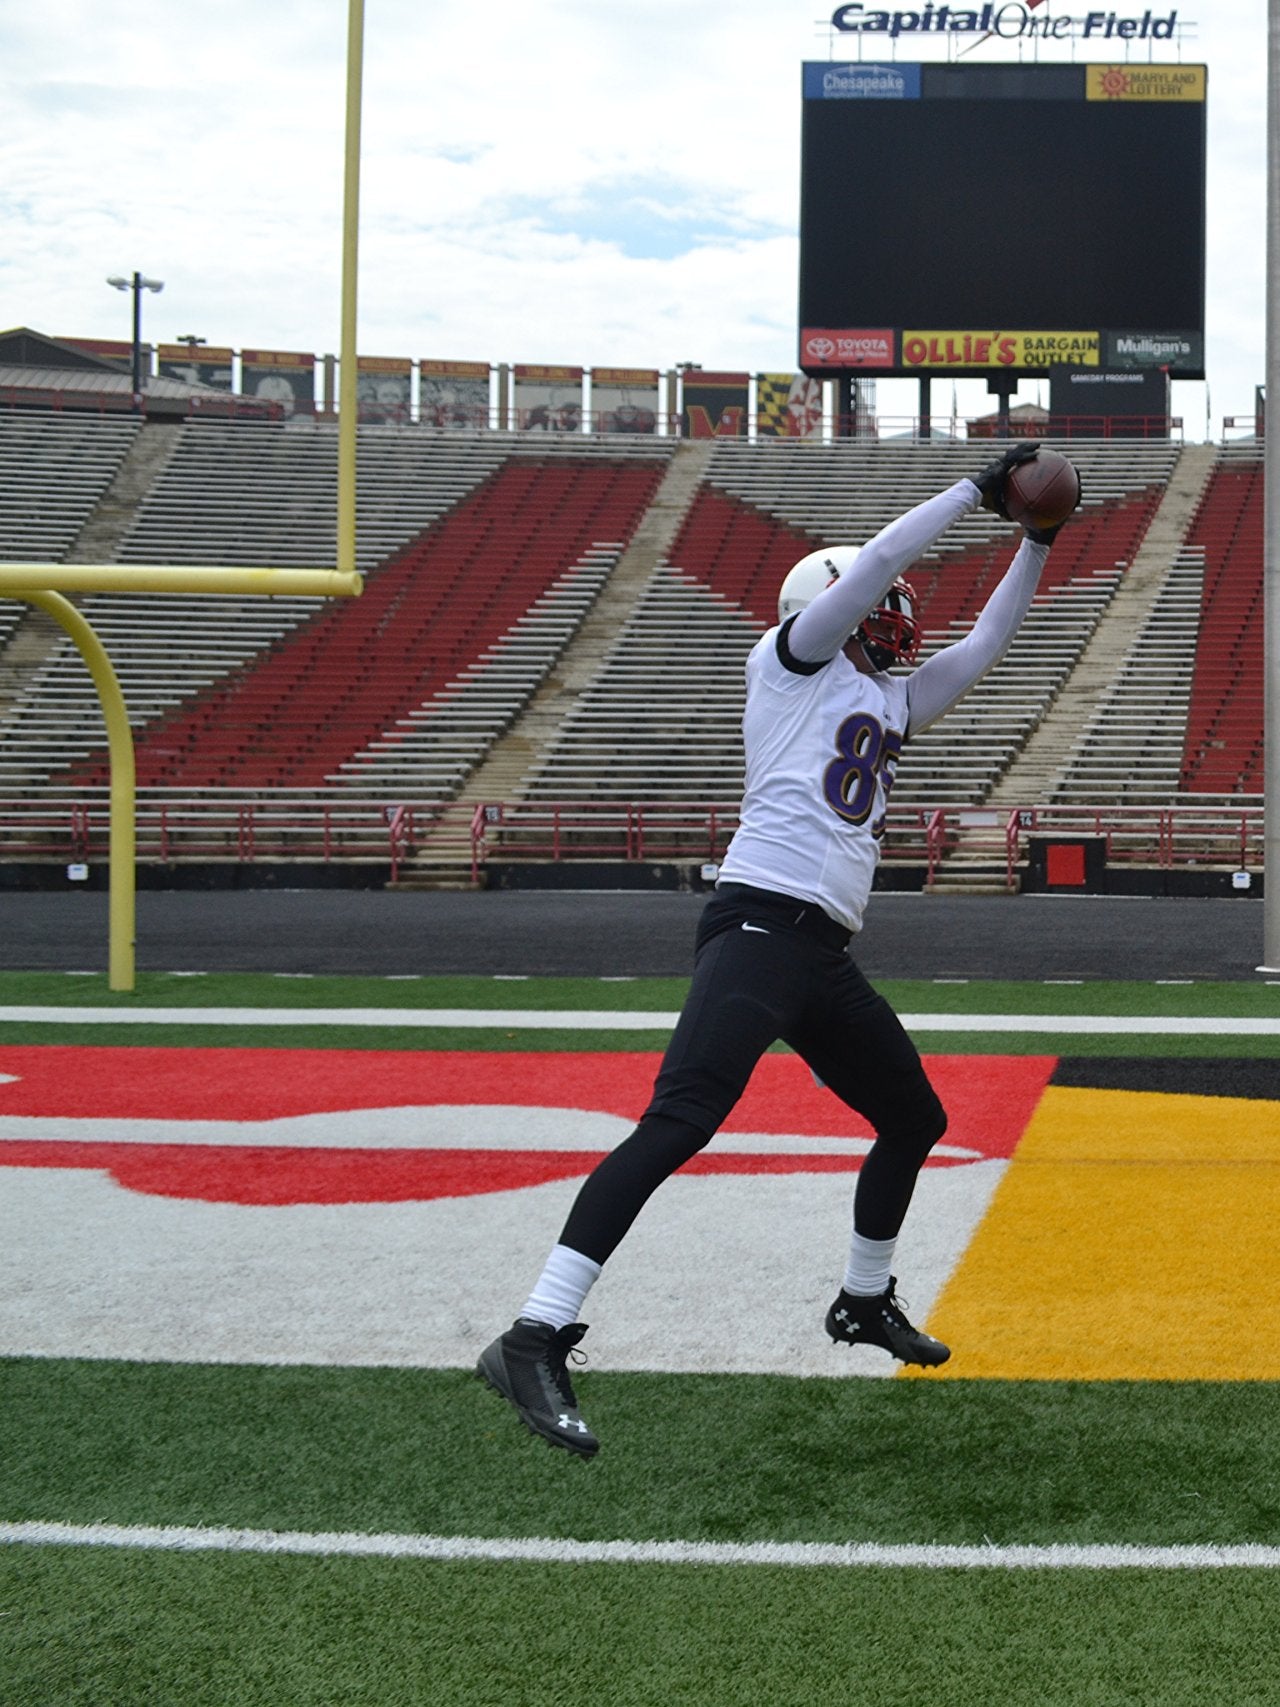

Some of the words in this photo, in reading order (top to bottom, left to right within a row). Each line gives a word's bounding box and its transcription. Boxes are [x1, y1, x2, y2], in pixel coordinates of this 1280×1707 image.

[1083, 9, 1178, 39] Field
[823, 73, 904, 93] Chesapeake
[1130, 73, 1196, 84] MARYLAND
[1130, 84, 1183, 95] LOTTERY
[837, 338, 888, 349] TOYOTA
[1023, 337, 1098, 351] BARGAIN
[1116, 339, 1191, 355] Mulligan's
[1023, 352, 1087, 366] OUTLET
